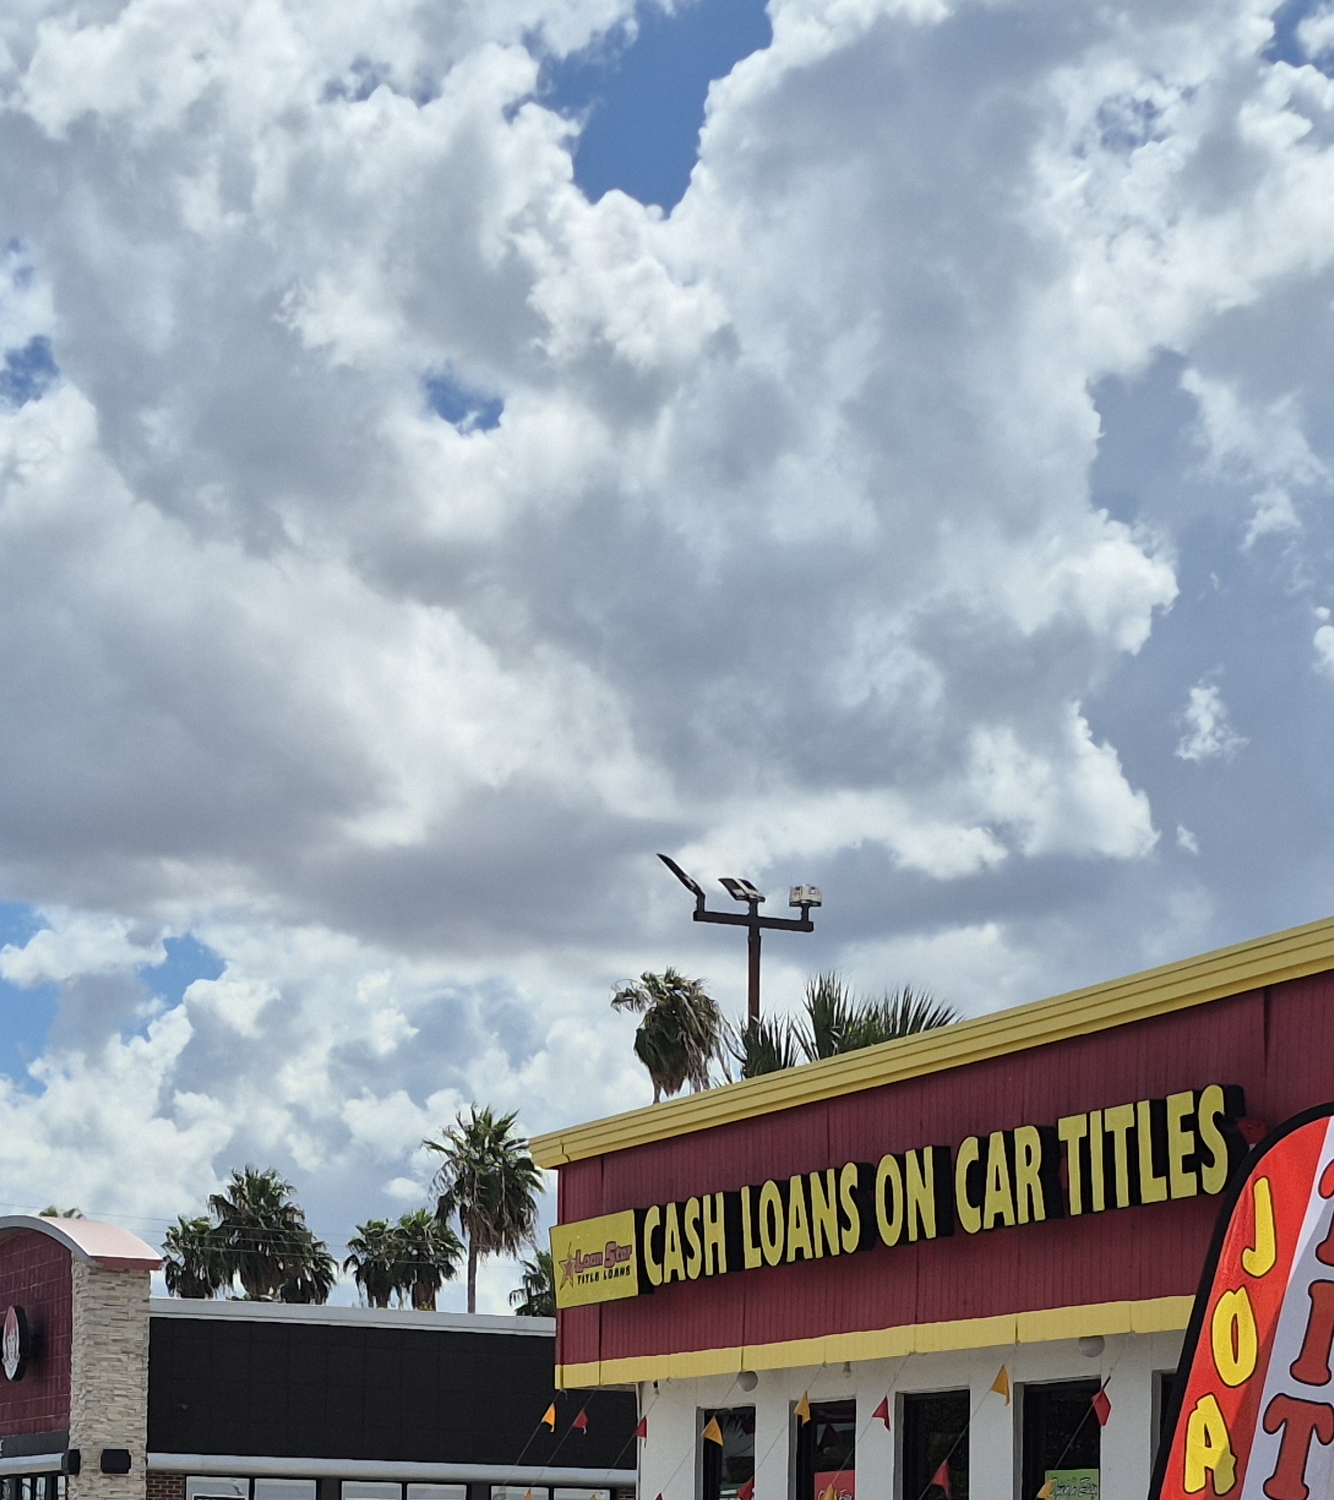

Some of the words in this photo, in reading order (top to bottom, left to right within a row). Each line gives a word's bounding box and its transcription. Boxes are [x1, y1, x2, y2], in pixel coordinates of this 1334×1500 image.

[644, 1192, 727, 1287] CASH
[741, 1162, 859, 1270] LOANS
[875, 1146, 936, 1247] ON
[955, 1125, 1046, 1234] CAR
[1058, 1084, 1226, 1216] TITLES
[575, 1248, 603, 1273] Loan
[604, 1240, 632, 1269] Star
[577, 1271, 599, 1285] TITLE
[603, 1265, 630, 1280] LOANS
